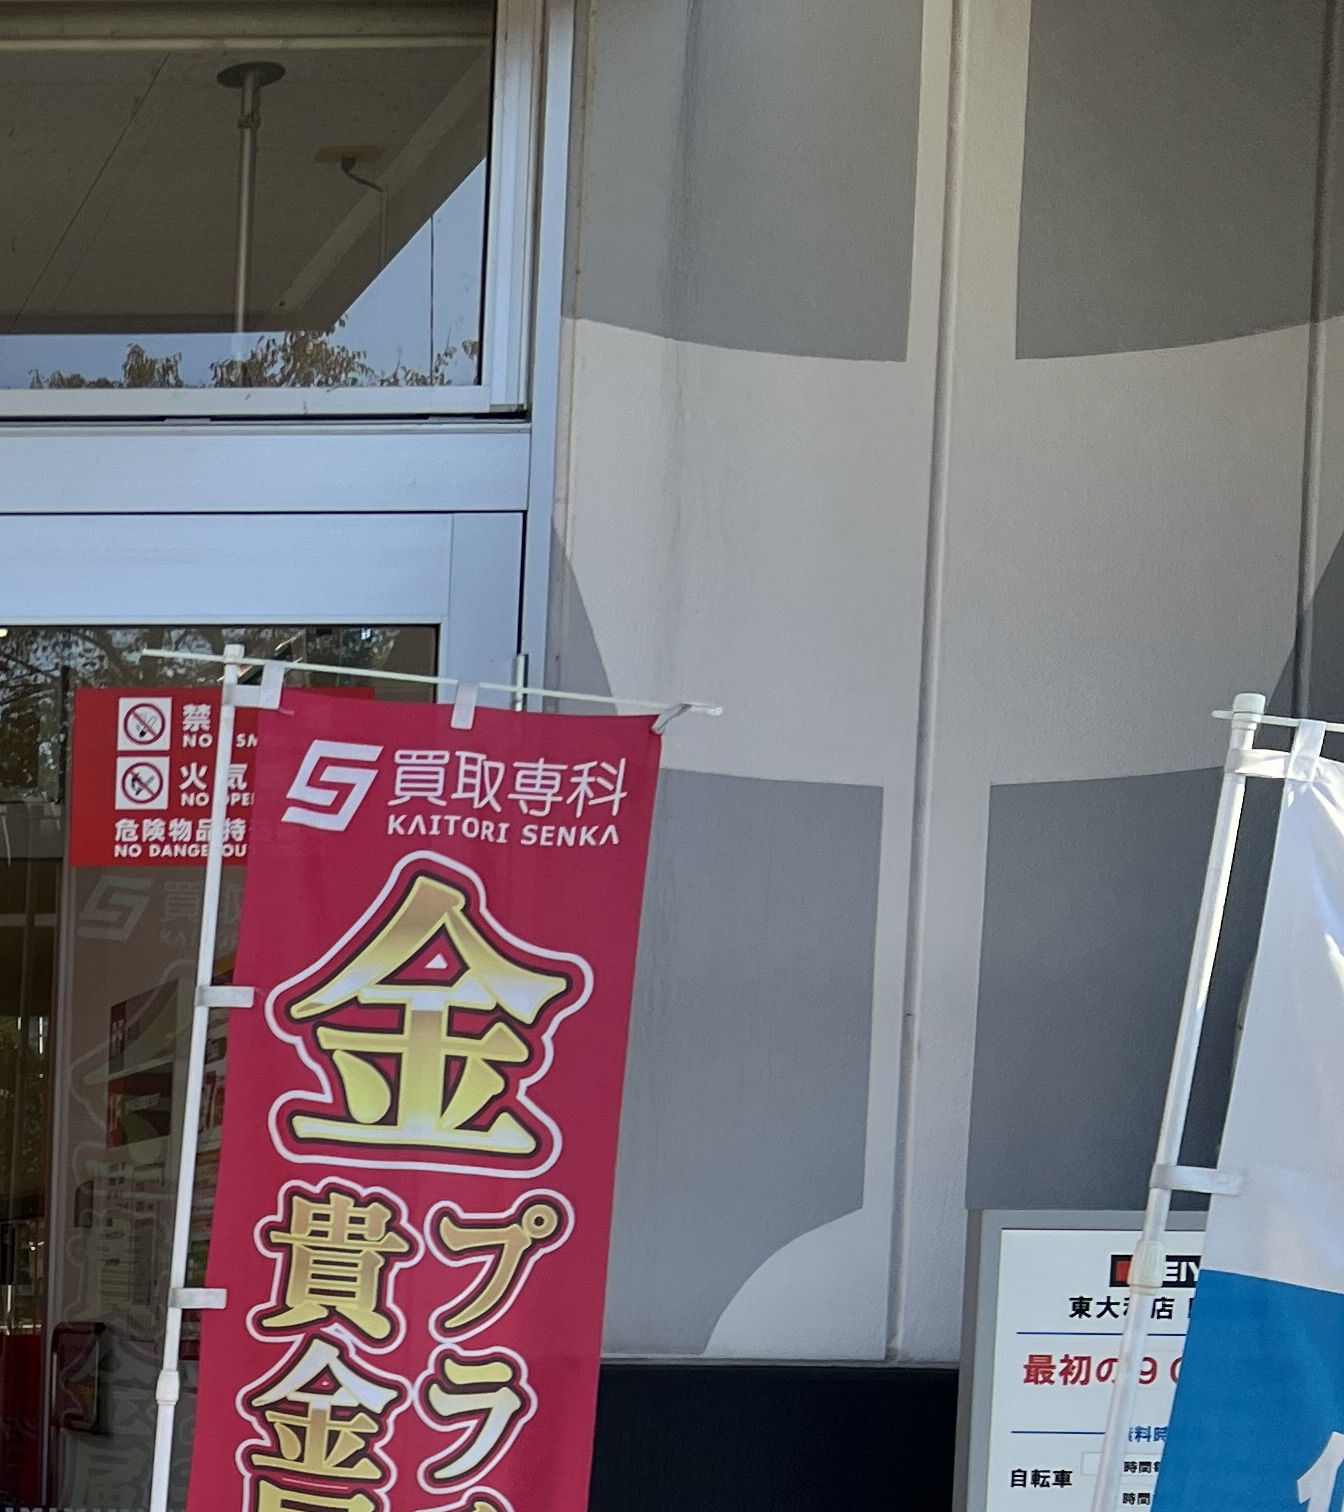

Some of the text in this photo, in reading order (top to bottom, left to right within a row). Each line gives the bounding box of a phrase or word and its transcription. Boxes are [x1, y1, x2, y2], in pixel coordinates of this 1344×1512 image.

[182, 733, 213, 748] NO
[389, 749, 629, 819] 買取専科
[180, 792, 210, 807] NO
[386, 814, 621, 848] KAITORI SENKA
[114, 843, 248, 858] NO DANGEOU
[282, 868, 572, 1160] 金
[1010, 1468, 1073, 1488] 自転車
